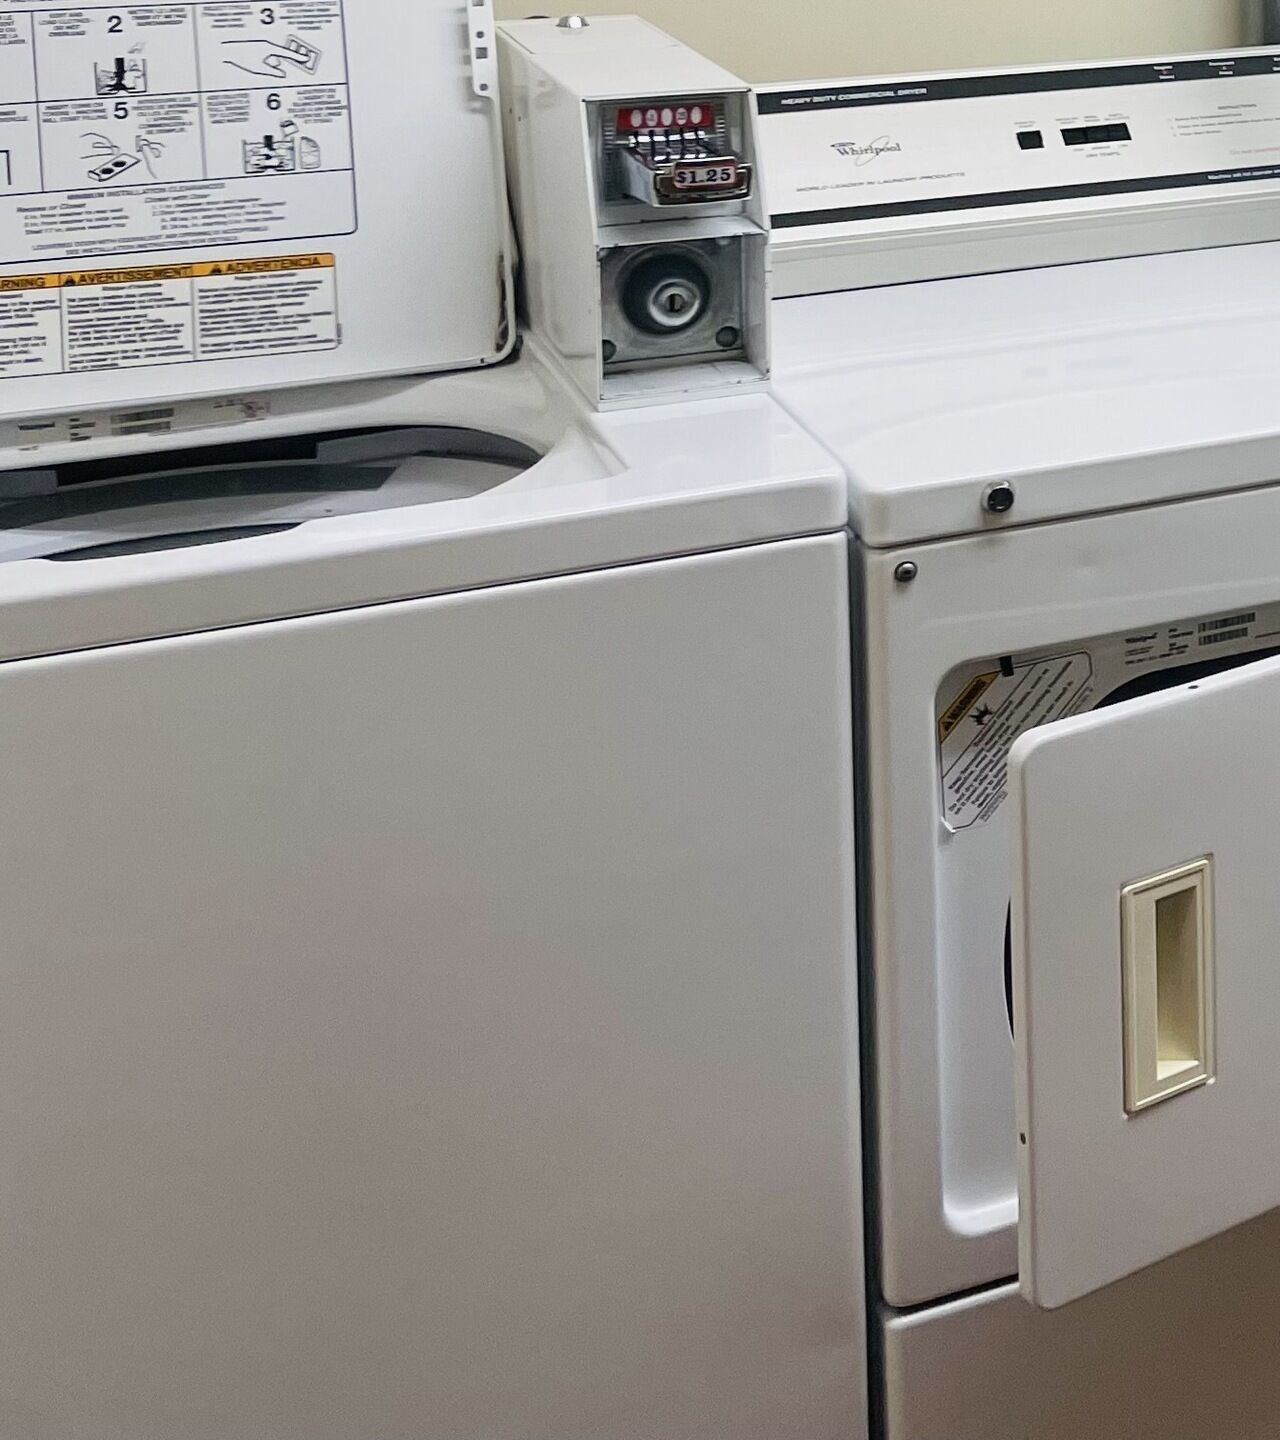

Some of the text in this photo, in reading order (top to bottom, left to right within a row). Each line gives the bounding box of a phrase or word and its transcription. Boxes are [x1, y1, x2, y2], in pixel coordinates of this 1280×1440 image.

[107, 15, 123, 33] 2
[260, 8, 274, 25] 3
[266, 93, 281, 110] 6
[114, 102, 129, 119] 5
[836, 142, 902, 156] Whirlpool
[676, 168, 731, 185] $1.25
